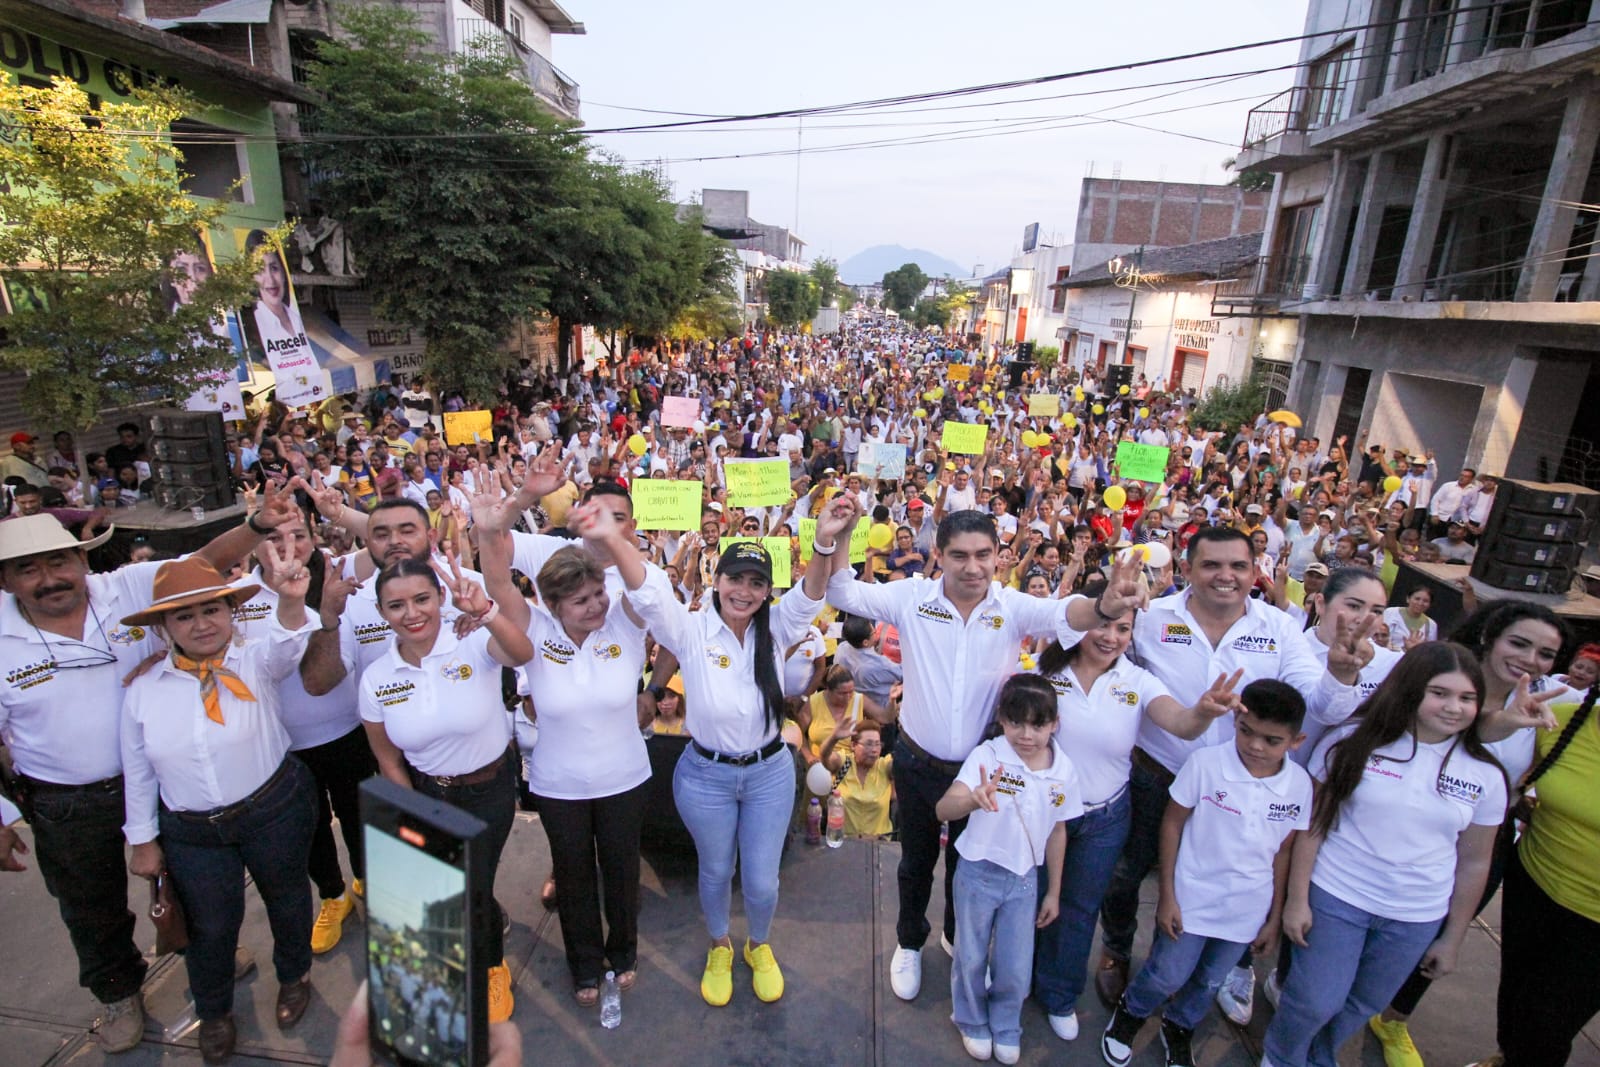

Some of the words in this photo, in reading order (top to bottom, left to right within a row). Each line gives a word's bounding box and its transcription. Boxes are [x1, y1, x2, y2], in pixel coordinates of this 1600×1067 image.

[267, 332, 308, 353] Araceli
[393, 352, 424, 369] BAÑO
[918, 605, 954, 620] VARONA
[1237, 635, 1277, 645] HAVITA
[9, 659, 49, 675] PABLO
[375, 682, 416, 698] VARONA
[379, 679, 410, 690] PABLO
[1439, 774, 1482, 794] CHAVITA
